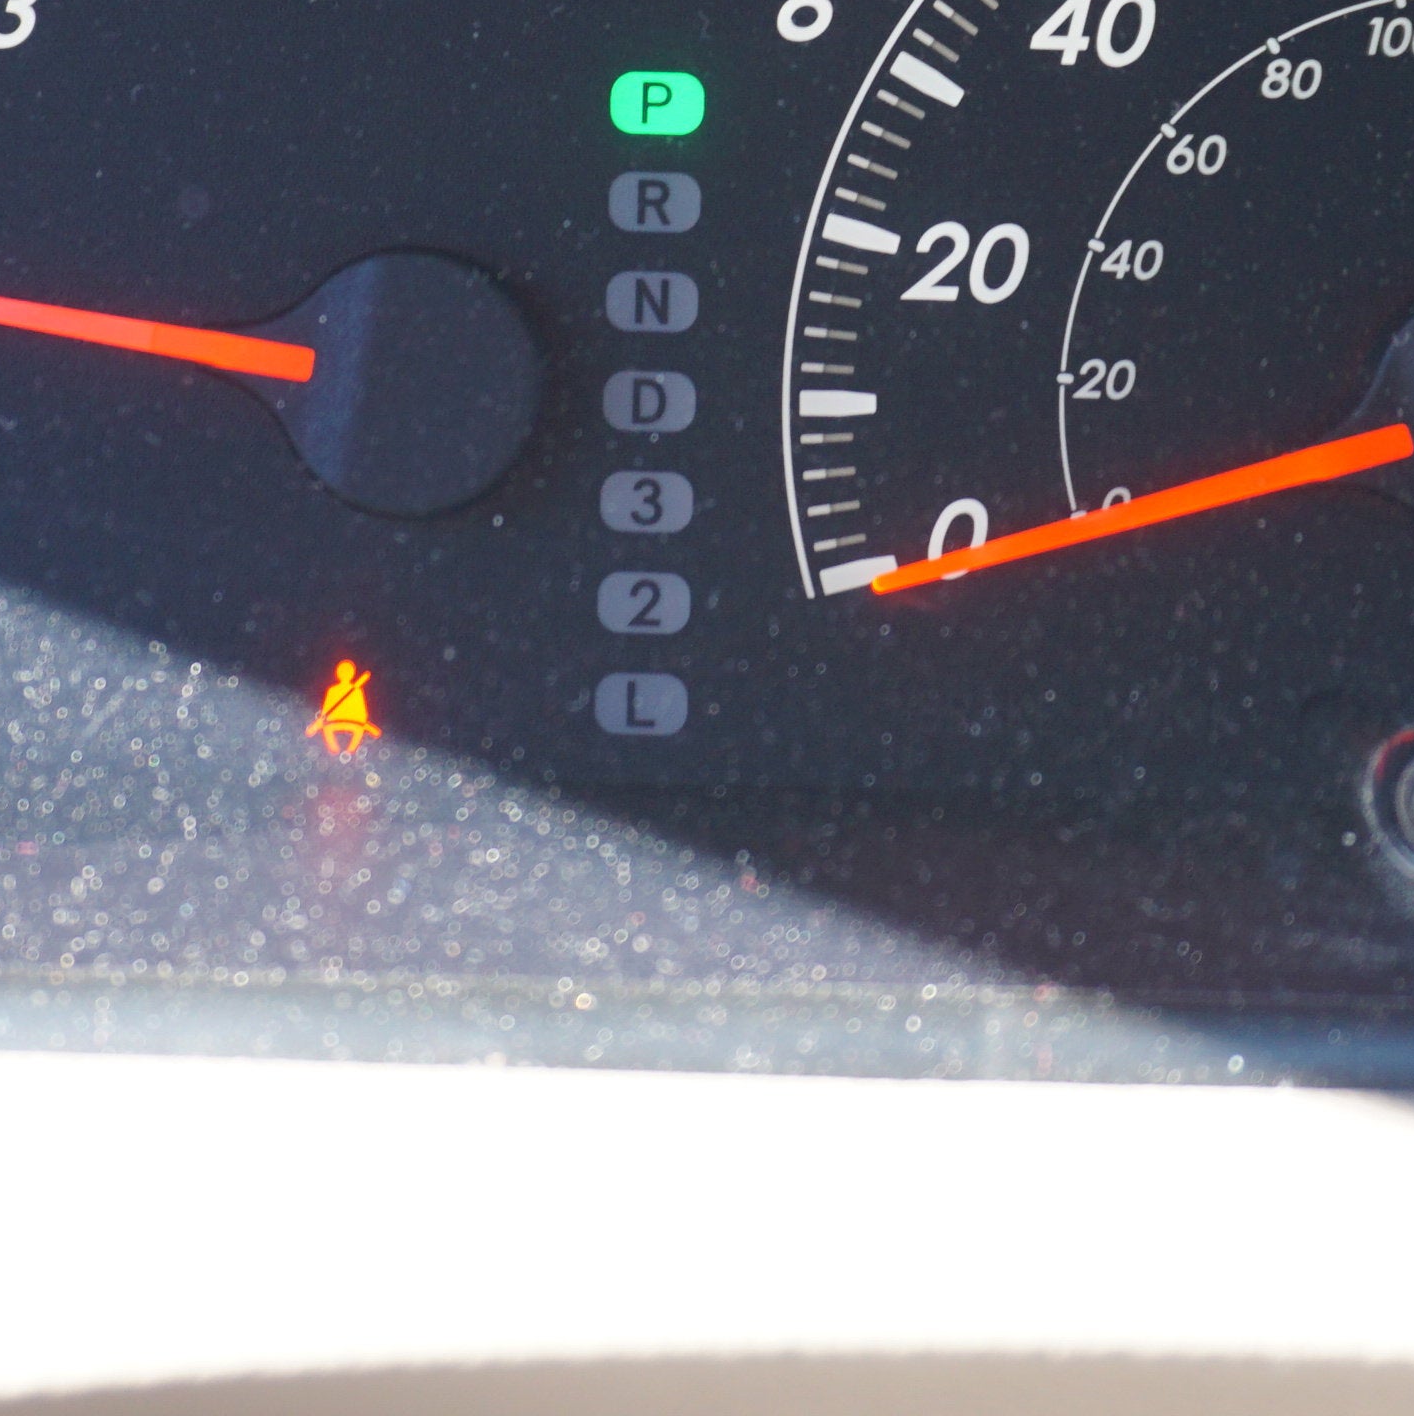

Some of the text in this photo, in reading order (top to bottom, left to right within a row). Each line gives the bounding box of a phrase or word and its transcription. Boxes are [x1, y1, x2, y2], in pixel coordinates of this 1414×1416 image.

[641, 81, 673, 124] P
[1261, 58, 1323, 100] 80
[1165, 133, 1227, 176] 60
[636, 178, 671, 226] R
[900, 221, 1030, 304] 20
[1099, 239, 1164, 281] 40
[633, 278, 670, 325] N
[631, 377, 668, 426] D
[1072, 358, 1136, 401] 20
[630, 477, 663, 527] 3
[927, 497, 990, 581] 0
[627, 578, 662, 628] 2
[625, 679, 656, 729] L
